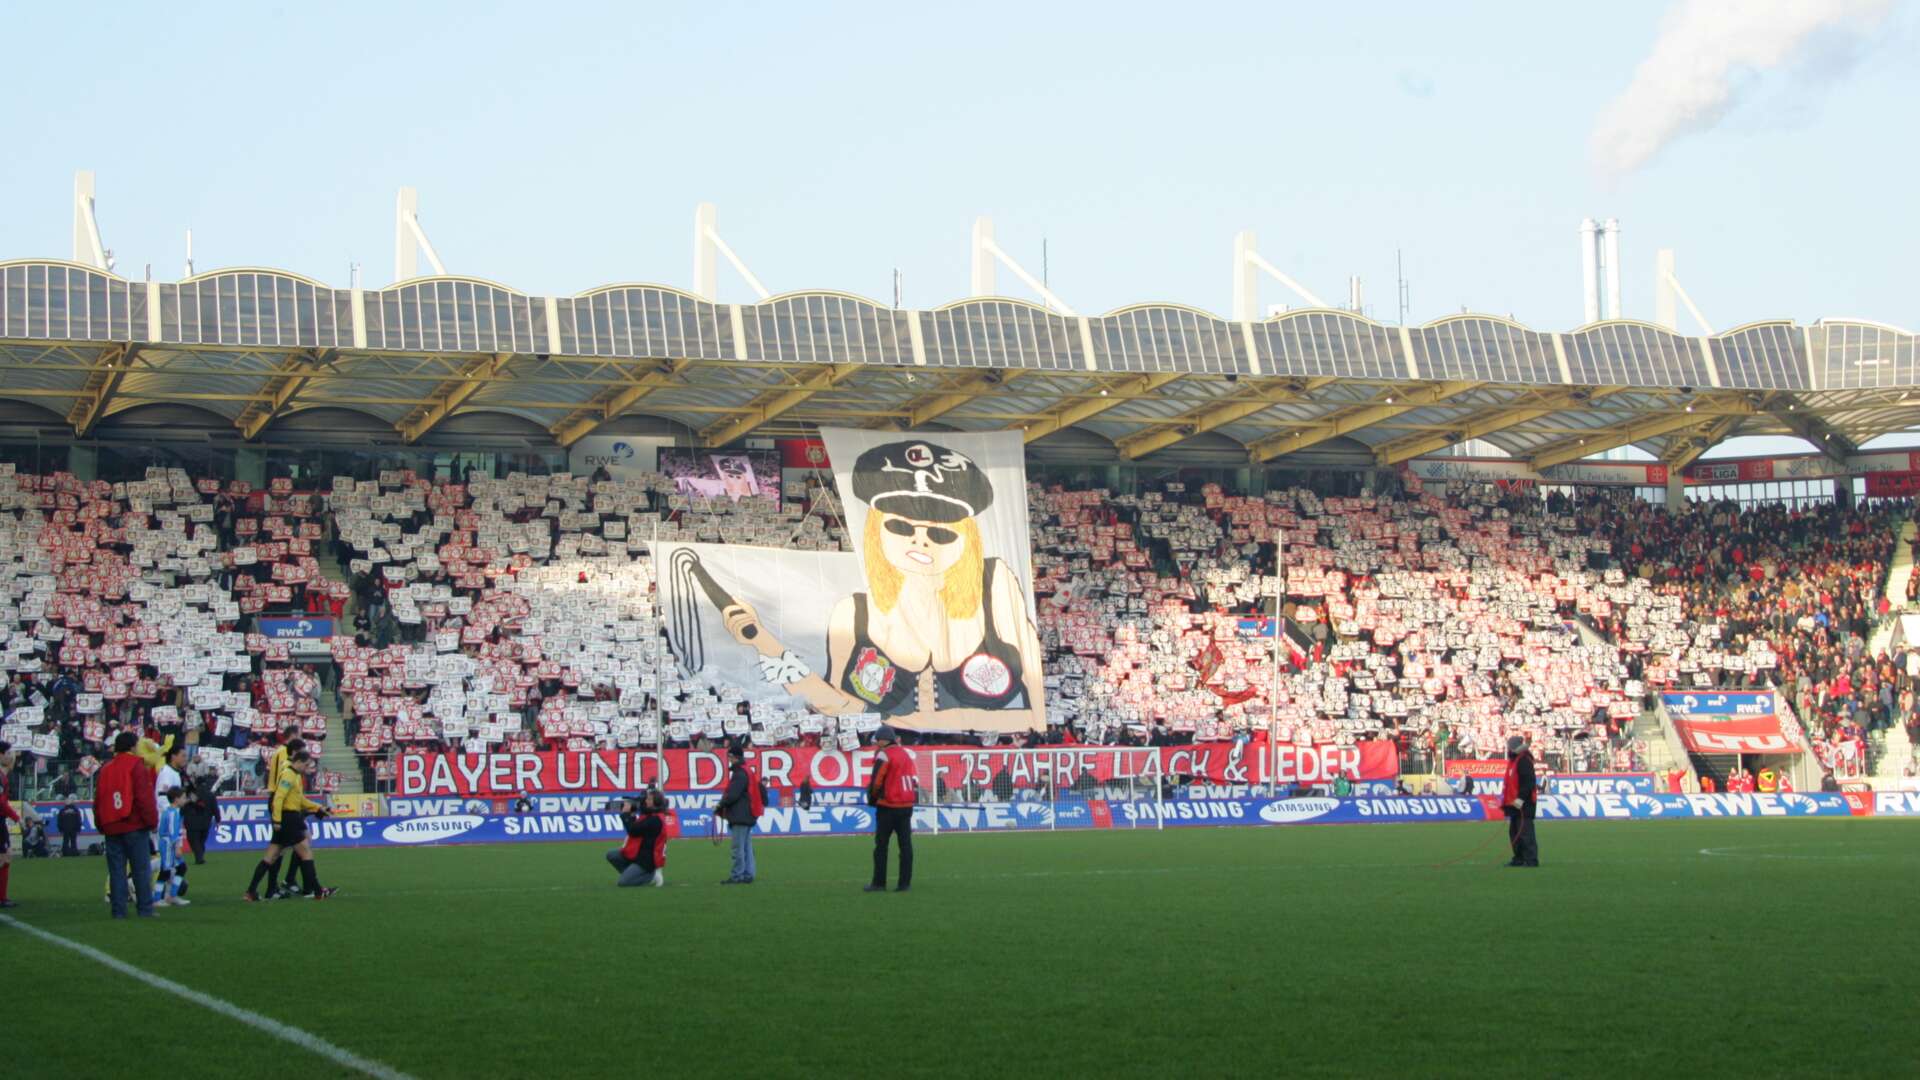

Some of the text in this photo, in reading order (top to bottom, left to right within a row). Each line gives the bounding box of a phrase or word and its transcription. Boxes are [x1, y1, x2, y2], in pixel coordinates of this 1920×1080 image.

[584, 456, 620, 466] RWE
[1714, 470, 1737, 479] LIGA
[276, 628, 304, 637] RWE
[1736, 703, 1763, 714] RWE
[1692, 731, 1788, 750] LTU
[403, 753, 543, 794] BAYER
[557, 752, 670, 789] UND
[688, 750, 793, 789] DR
[811, 748, 918, 787] OF
[1224, 747, 1248, 782] &
[1259, 746, 1360, 782] LEDER
[1559, 779, 1615, 793] RWE
[113, 791, 123, 810] 8
[1269, 802, 1332, 812] SAMSUNG
[1358, 797, 1472, 816] SAMSUNG
[1534, 794, 1631, 816] RWE
[1685, 794, 1786, 816] RWE
[1123, 801, 1244, 820] SAMSUNG
[215, 821, 363, 844] SAMUNG
[395, 821, 473, 832] SAMSUNG
[504, 813, 625, 835] SAMSUN
